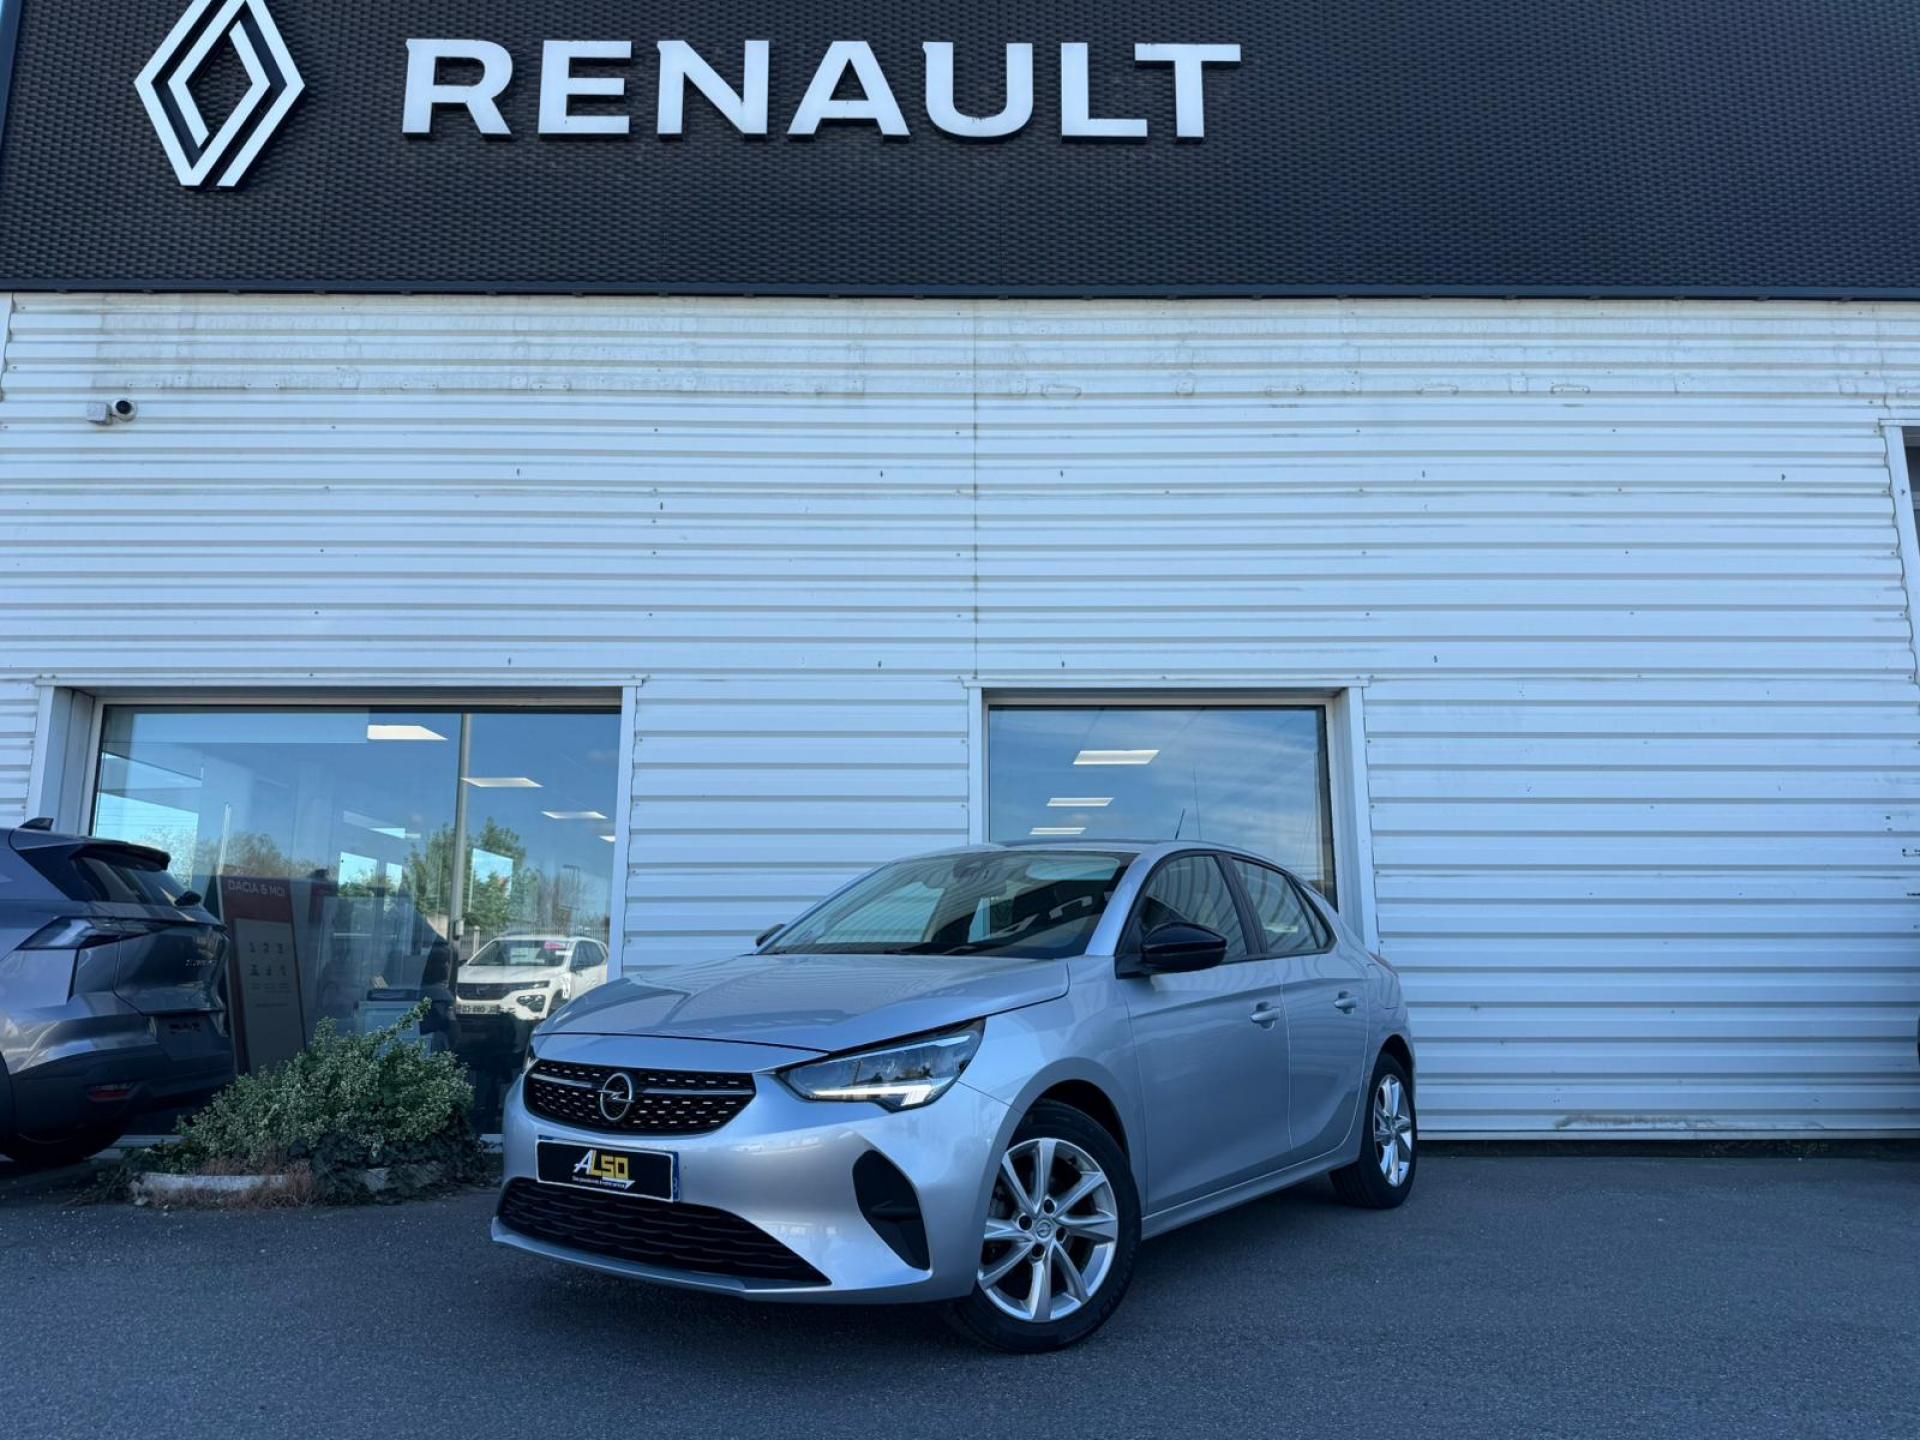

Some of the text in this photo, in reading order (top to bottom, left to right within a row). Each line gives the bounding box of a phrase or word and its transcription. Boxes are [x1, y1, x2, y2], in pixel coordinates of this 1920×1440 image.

[402, 37, 1242, 140] RENAULT
[227, 879, 259, 894] DACIA
[572, 1149, 630, 1179] ALSO
